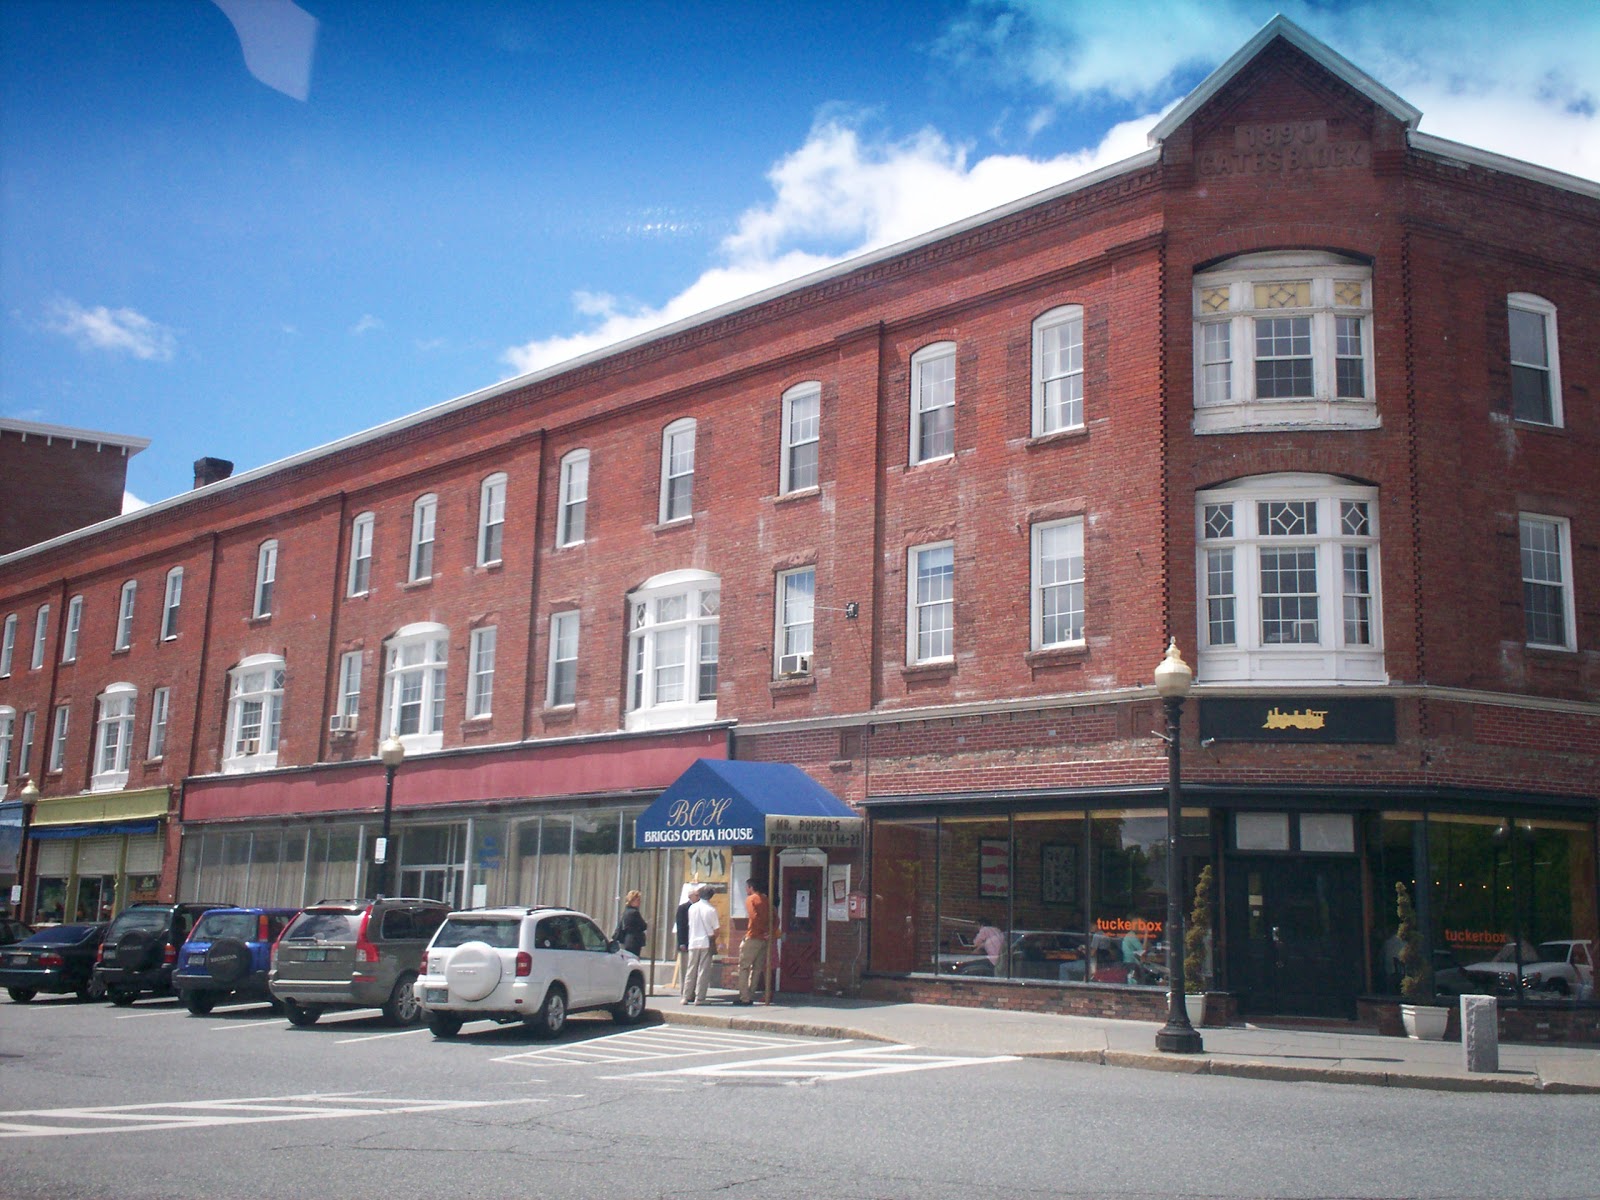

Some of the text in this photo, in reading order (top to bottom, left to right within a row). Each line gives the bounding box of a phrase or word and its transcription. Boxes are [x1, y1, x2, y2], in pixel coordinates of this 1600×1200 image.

[1244, 125, 1318, 147] 1890
[776, 819, 840, 832] MR. POPPER'S
[644, 828, 753, 842] BRIGGS OPERA HOUSE
[770, 832, 814, 844] PENGUINS
[816, 832, 834, 845] MAY
[1097, 918, 1162, 931] tuckerbox
[1445, 929, 1506, 943] tuckerbox
